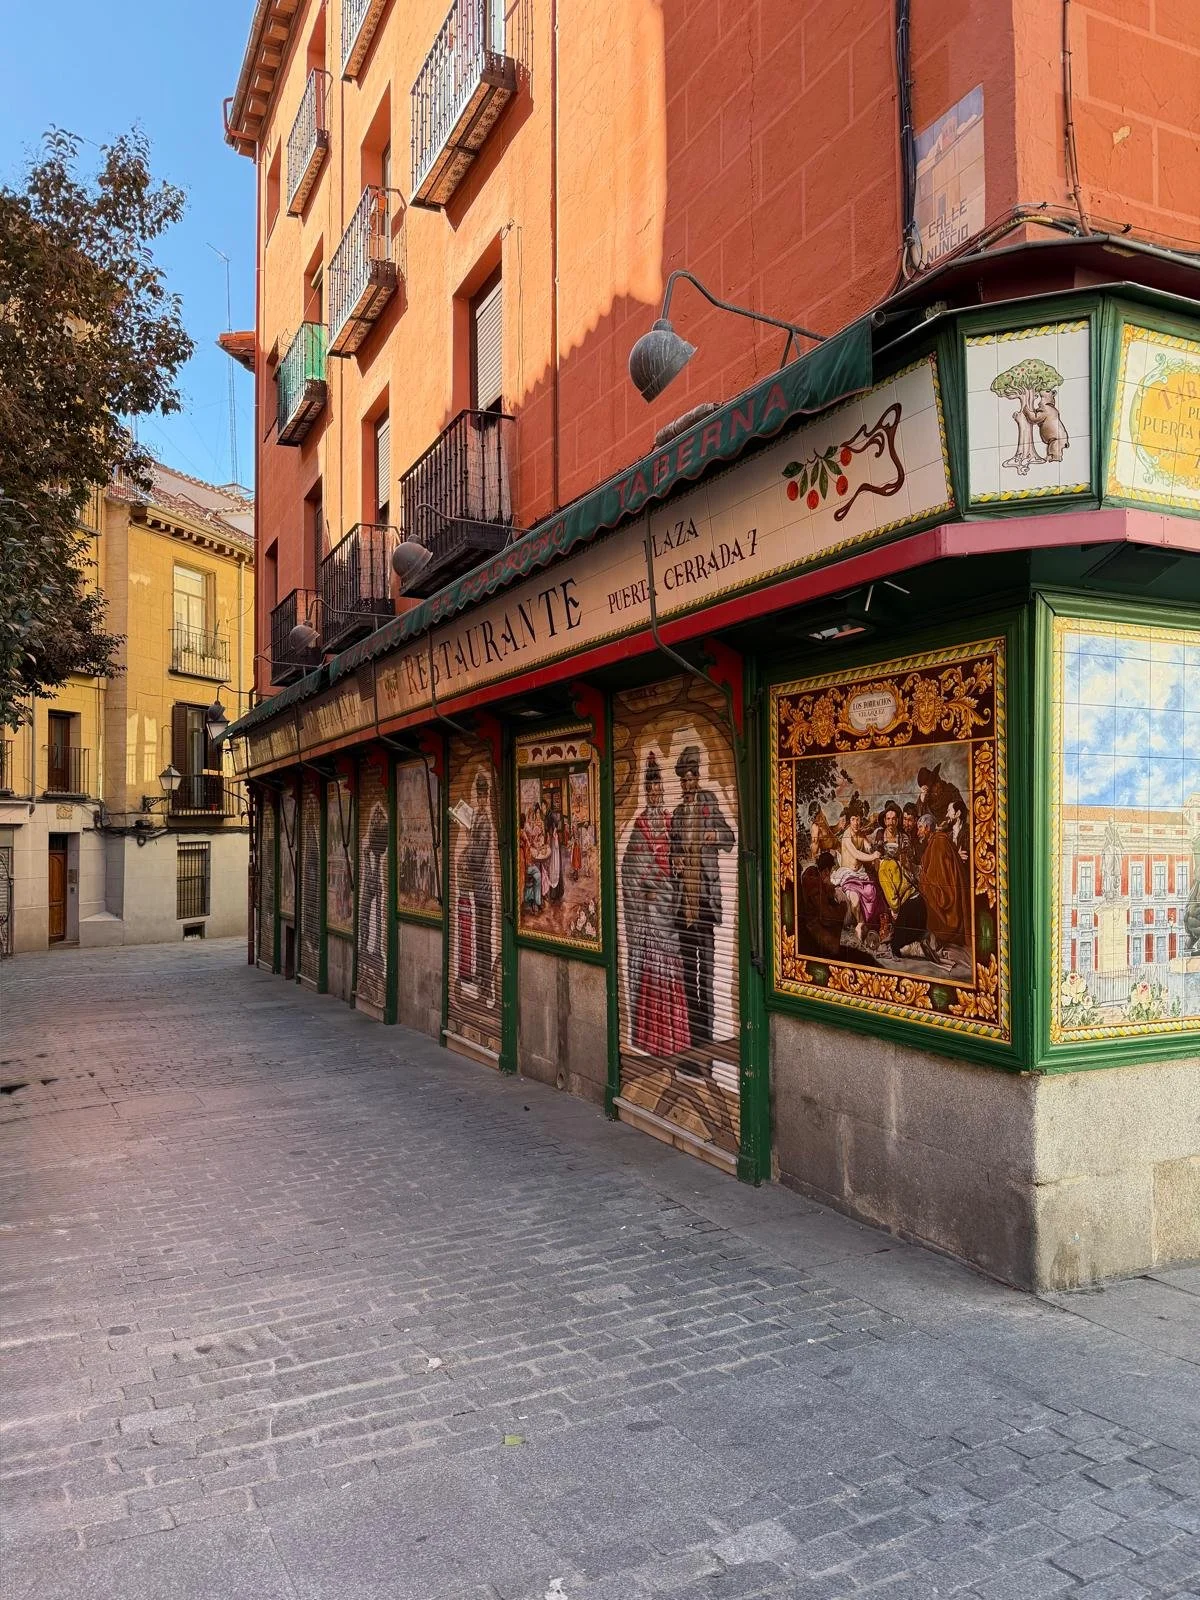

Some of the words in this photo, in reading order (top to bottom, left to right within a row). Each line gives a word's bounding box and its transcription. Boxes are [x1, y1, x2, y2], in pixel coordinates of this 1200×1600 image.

[928, 198, 968, 239] CALLE
[939, 223, 957, 241] DEL
[926, 223, 969, 264] NUNCIO
[613, 383, 788, 508] TABERNA
[1143, 415, 1193, 440] PUERTA
[663, 537, 745, 591] CERRADA
[747, 528, 758, 557] 7
[852, 702, 863, 711] LOS
